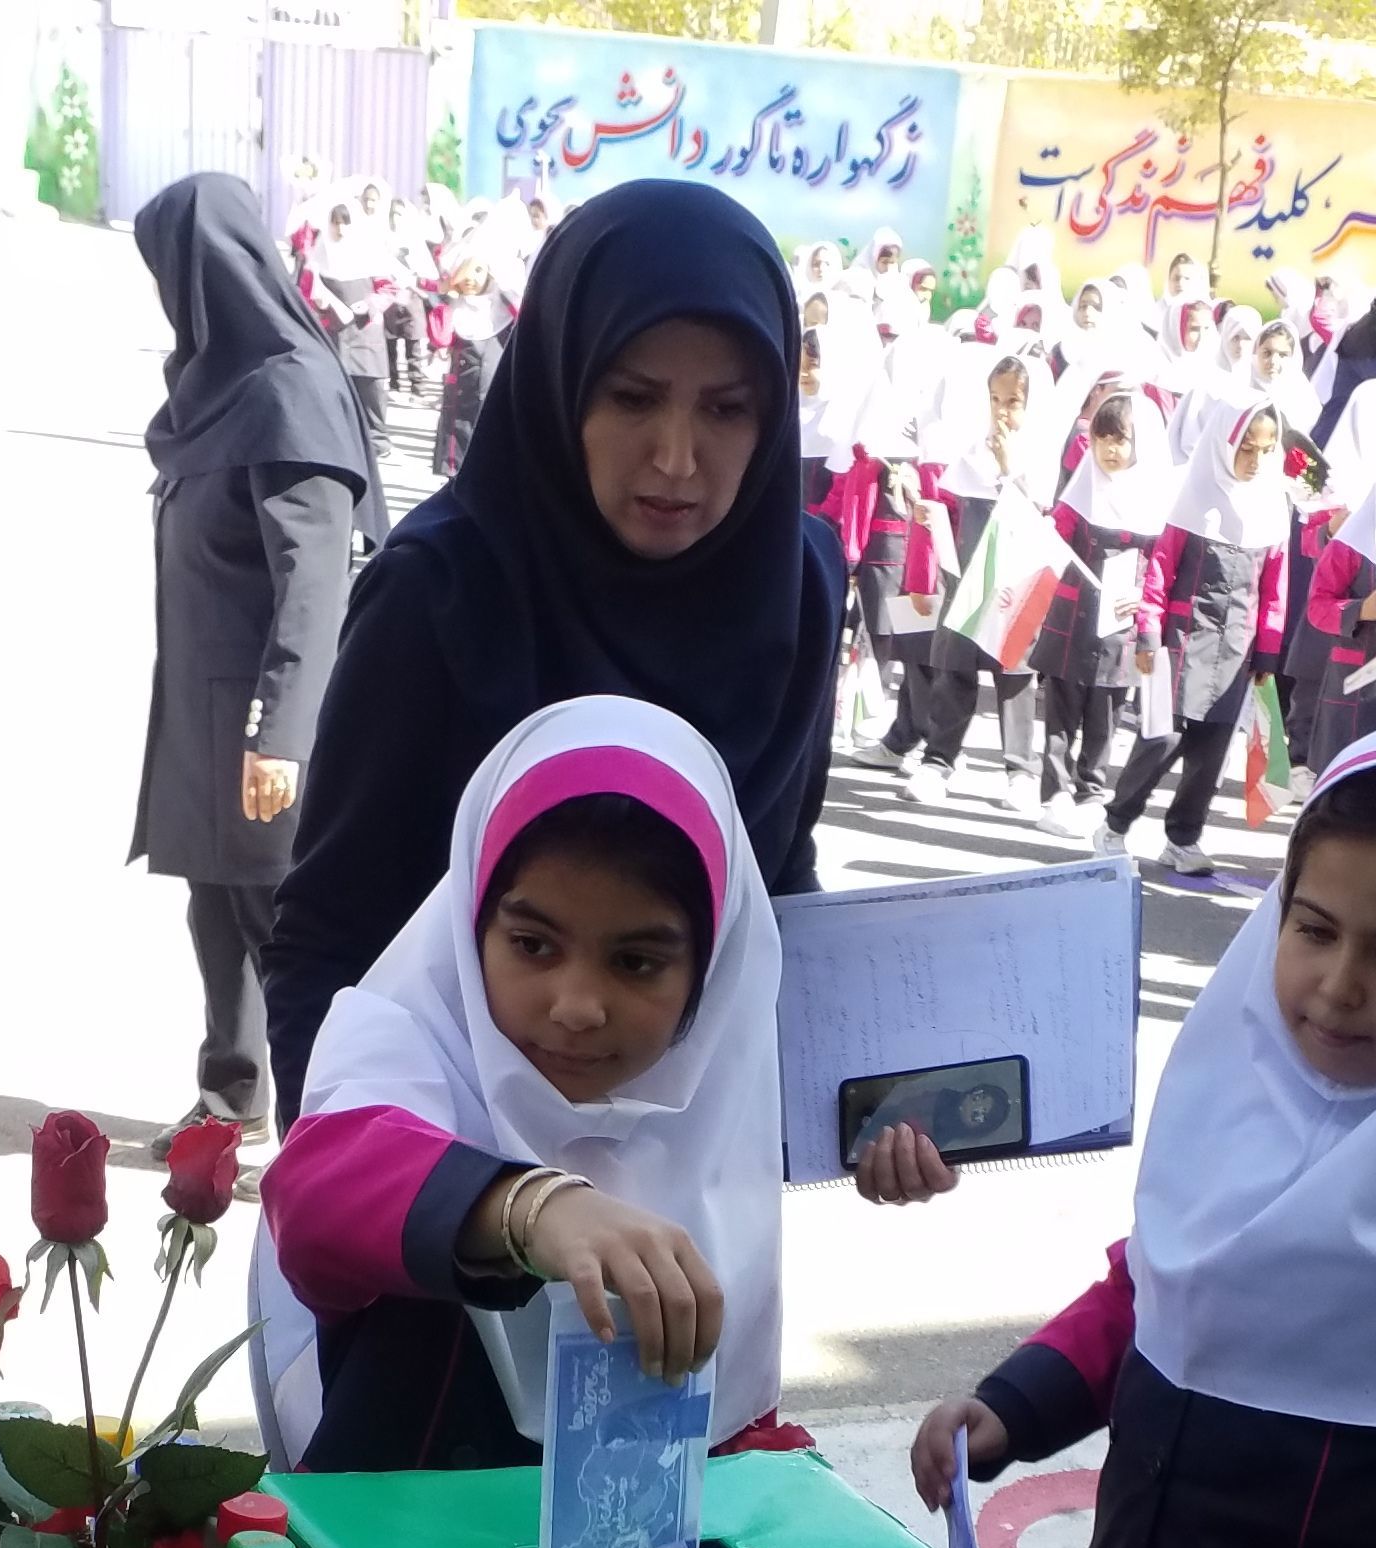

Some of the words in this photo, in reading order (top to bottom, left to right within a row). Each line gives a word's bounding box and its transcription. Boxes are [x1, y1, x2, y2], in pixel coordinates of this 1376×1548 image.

[561, 66, 709, 173] دانش
[710, 83, 798, 178] گور
[768, 109, 805, 174] تا
[1019, 147, 1096, 223] است
[1070, 128, 1191, 244] زندگی
[1143, 133, 1277, 266] فهم
[1233, 153, 1344, 260] کلید
